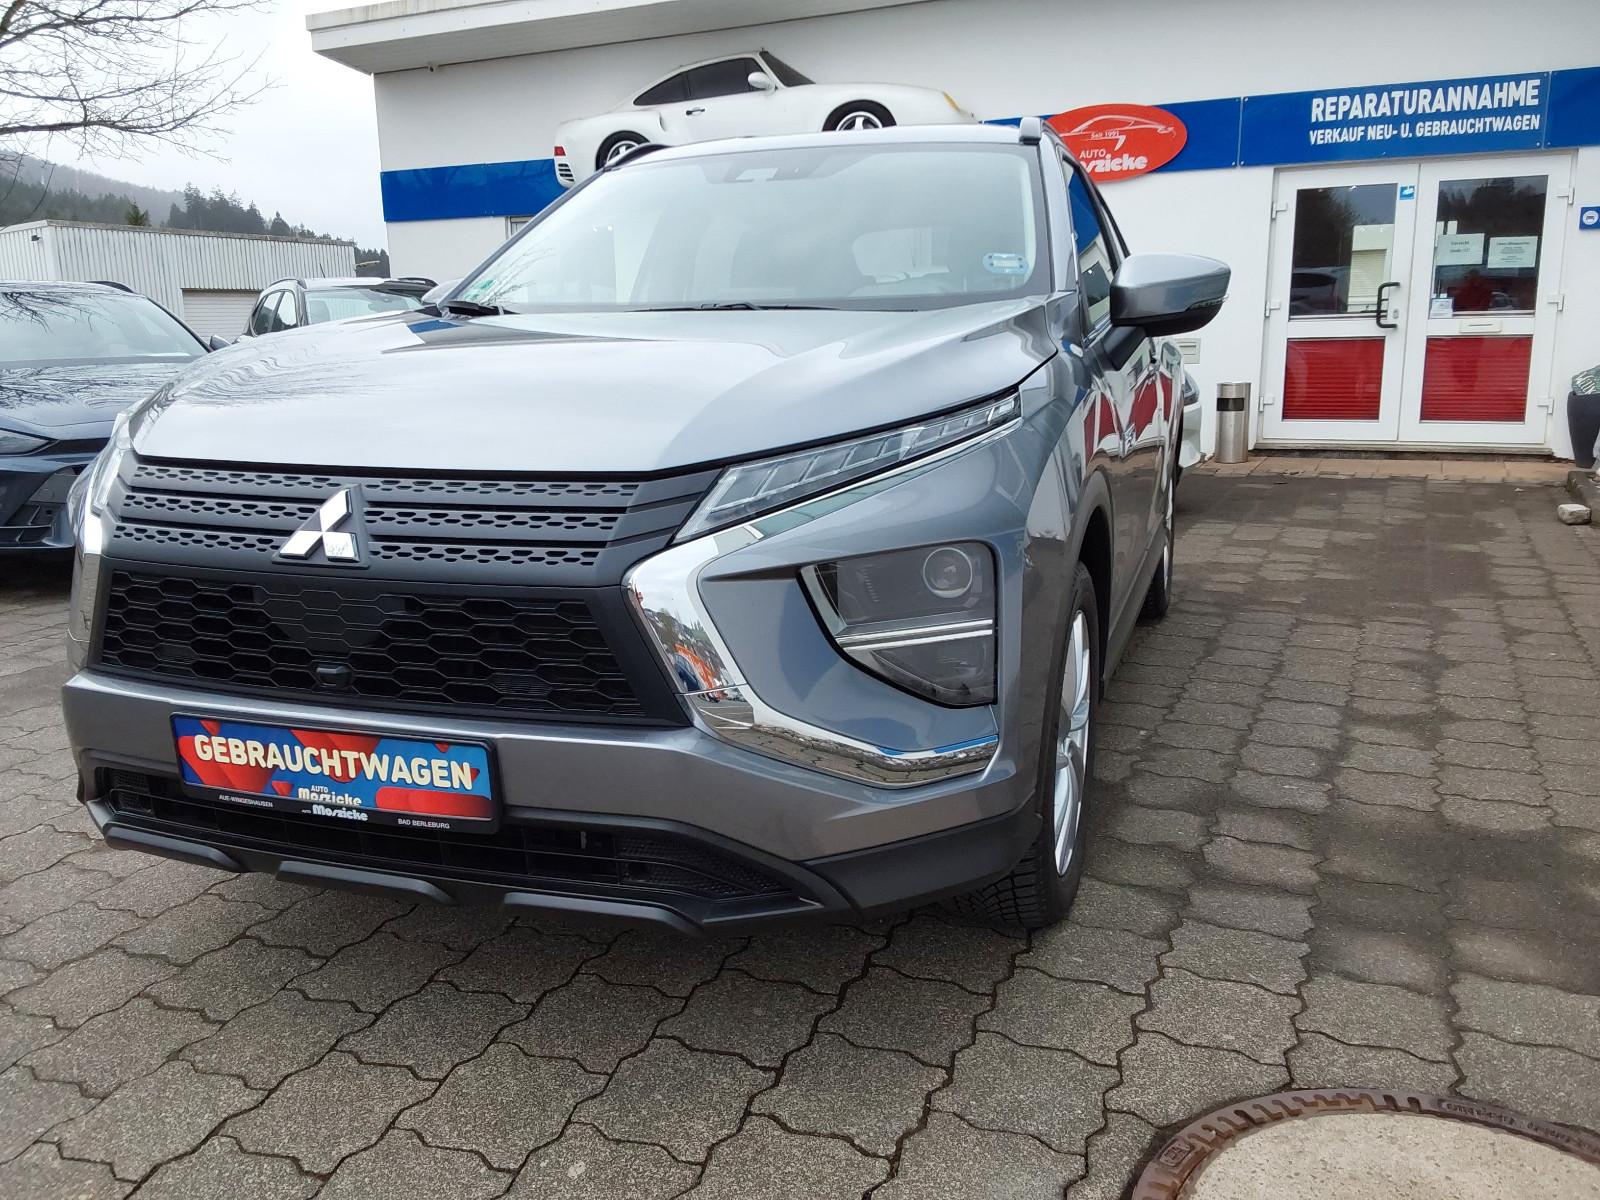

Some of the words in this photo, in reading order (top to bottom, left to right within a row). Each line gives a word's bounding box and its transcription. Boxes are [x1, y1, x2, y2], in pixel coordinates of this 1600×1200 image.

[1310, 79, 1541, 123] REPARATURANNAHME
[1309, 126, 1365, 146] VERKAUF
[1366, 123, 1398, 141] NEU-
[1400, 122, 1413, 138] U.
[1415, 114, 1541, 137] GEBRAUCHTWAGEN
[1079, 148, 1106, 159] AUTO
[193, 734, 473, 791] GEBRAUCHTWAGEN
[310, 784, 329, 793] AUTO
[397, 818, 411, 826] BAD
[412, 820, 450, 829] BERLEBURG
